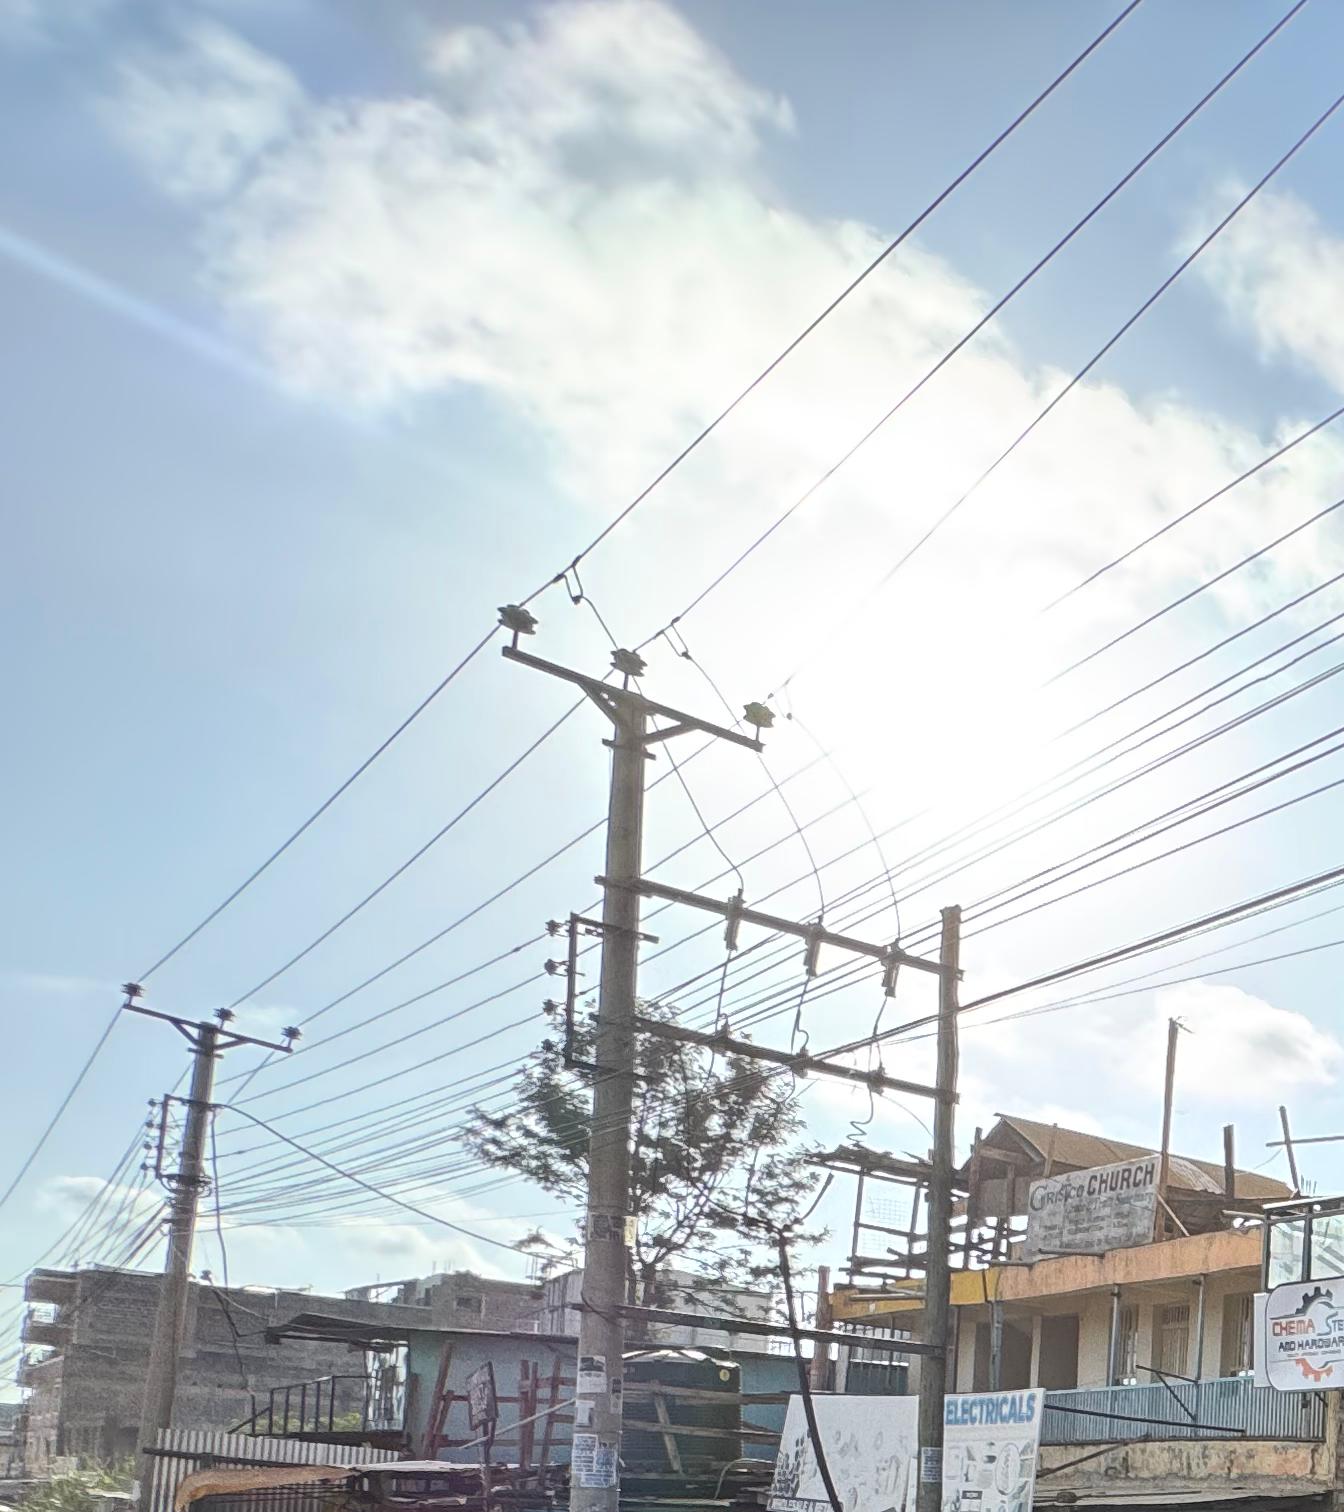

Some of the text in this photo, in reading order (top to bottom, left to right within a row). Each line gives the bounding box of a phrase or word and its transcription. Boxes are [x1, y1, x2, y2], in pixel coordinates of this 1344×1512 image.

[1087, 1163, 1156, 1196] CHURCH
[1272, 1318, 1315, 1337] CHEMA
[944, 1392, 1037, 1425] ELECTRICALS
